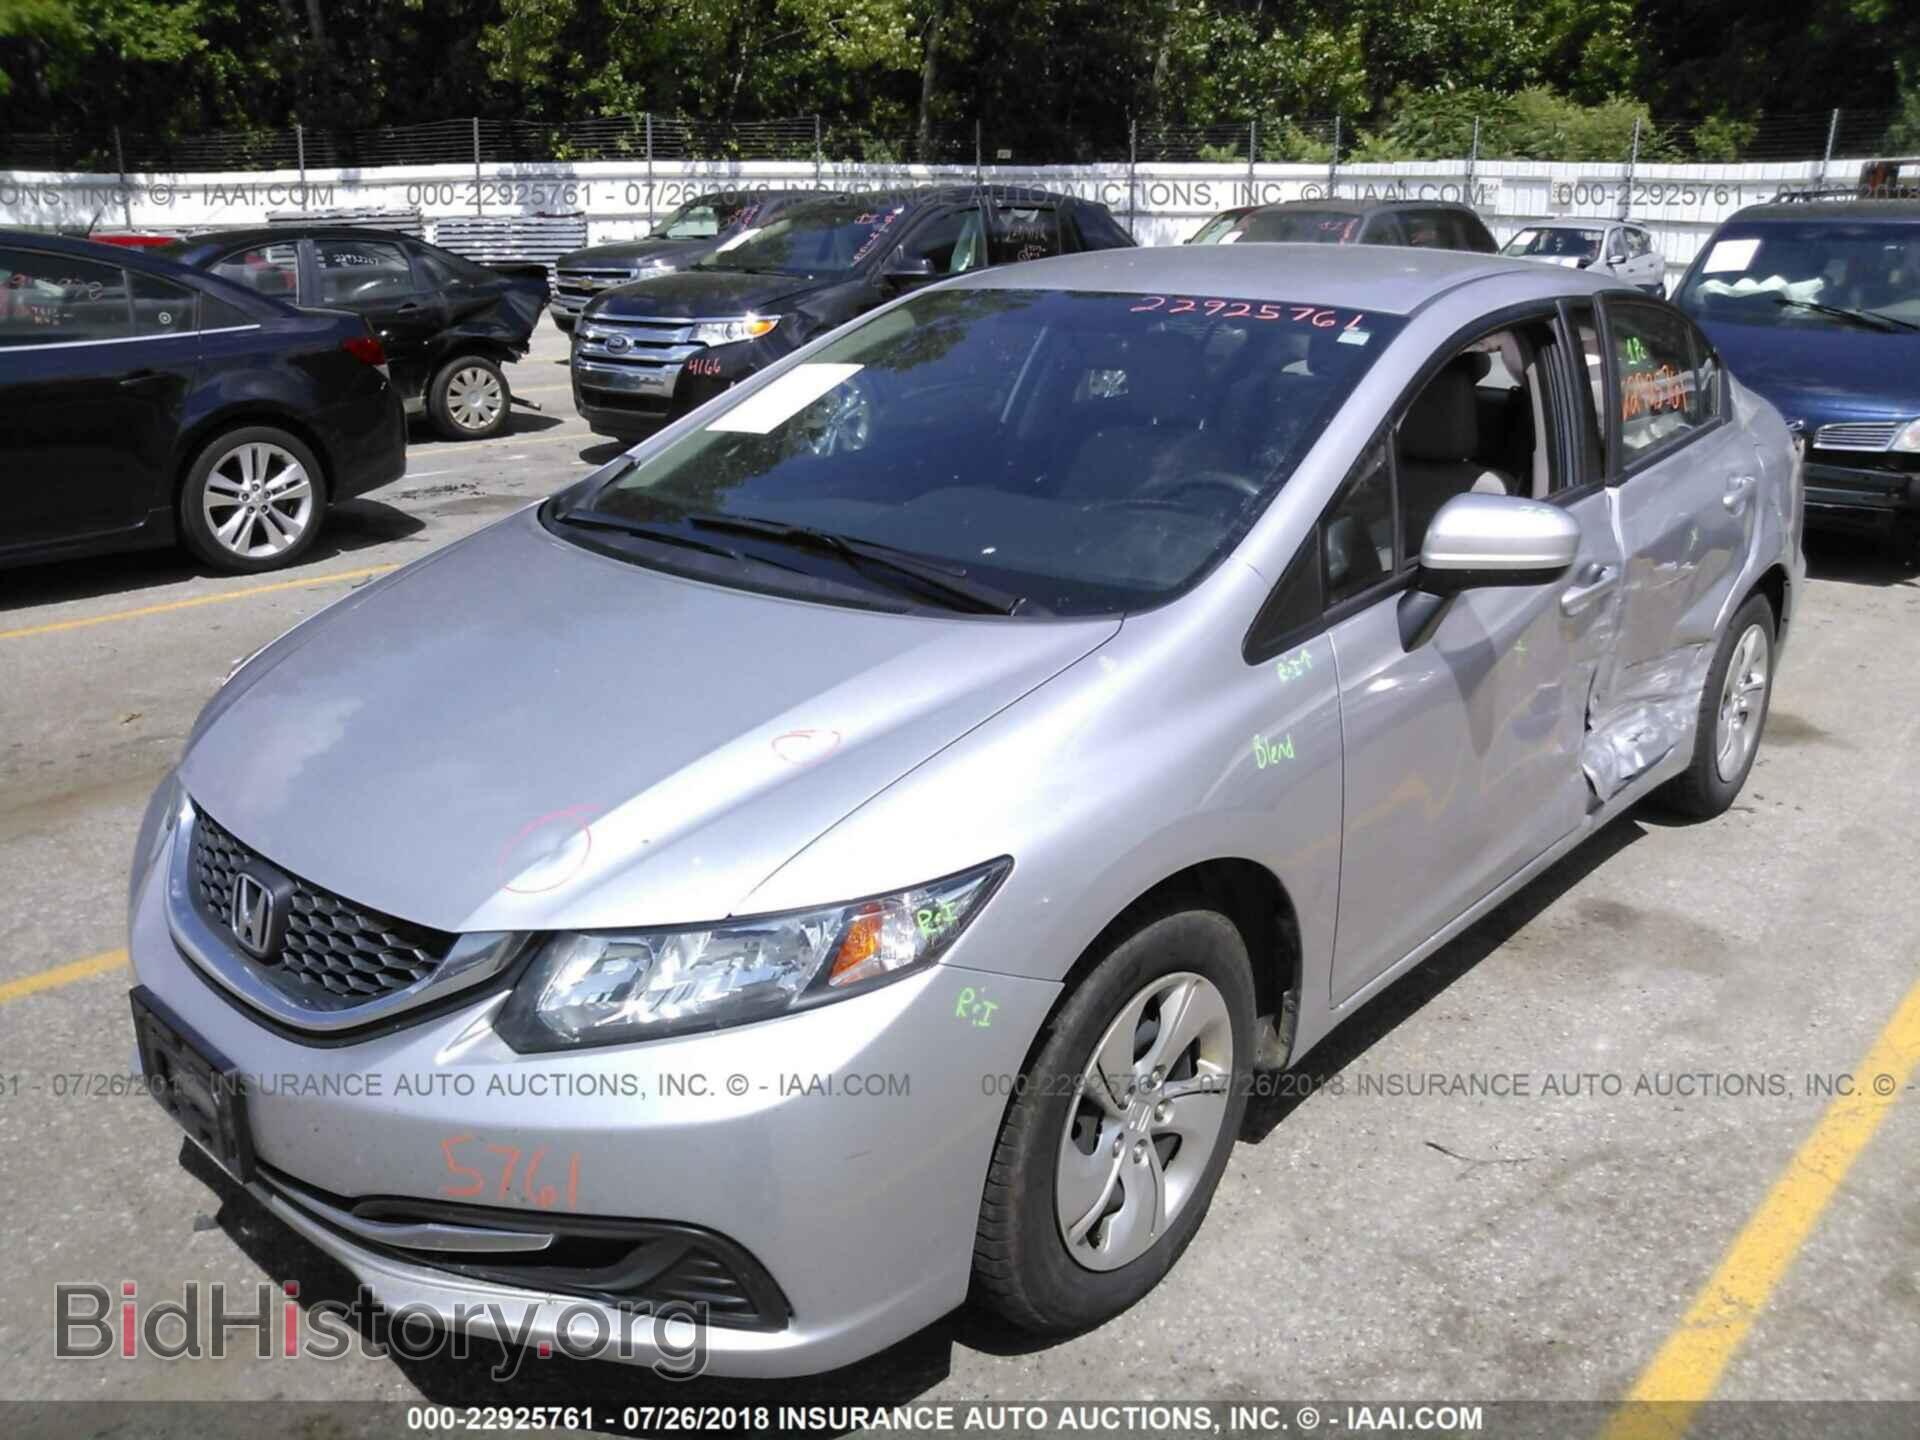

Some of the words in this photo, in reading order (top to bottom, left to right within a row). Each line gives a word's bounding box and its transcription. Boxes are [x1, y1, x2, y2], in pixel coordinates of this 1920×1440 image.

[1130, 296, 1363, 331] 22925761
[688, 358, 721, 375] 4166
[1253, 734, 1295, 769] Blend
[440, 1135, 581, 1210] 5761
